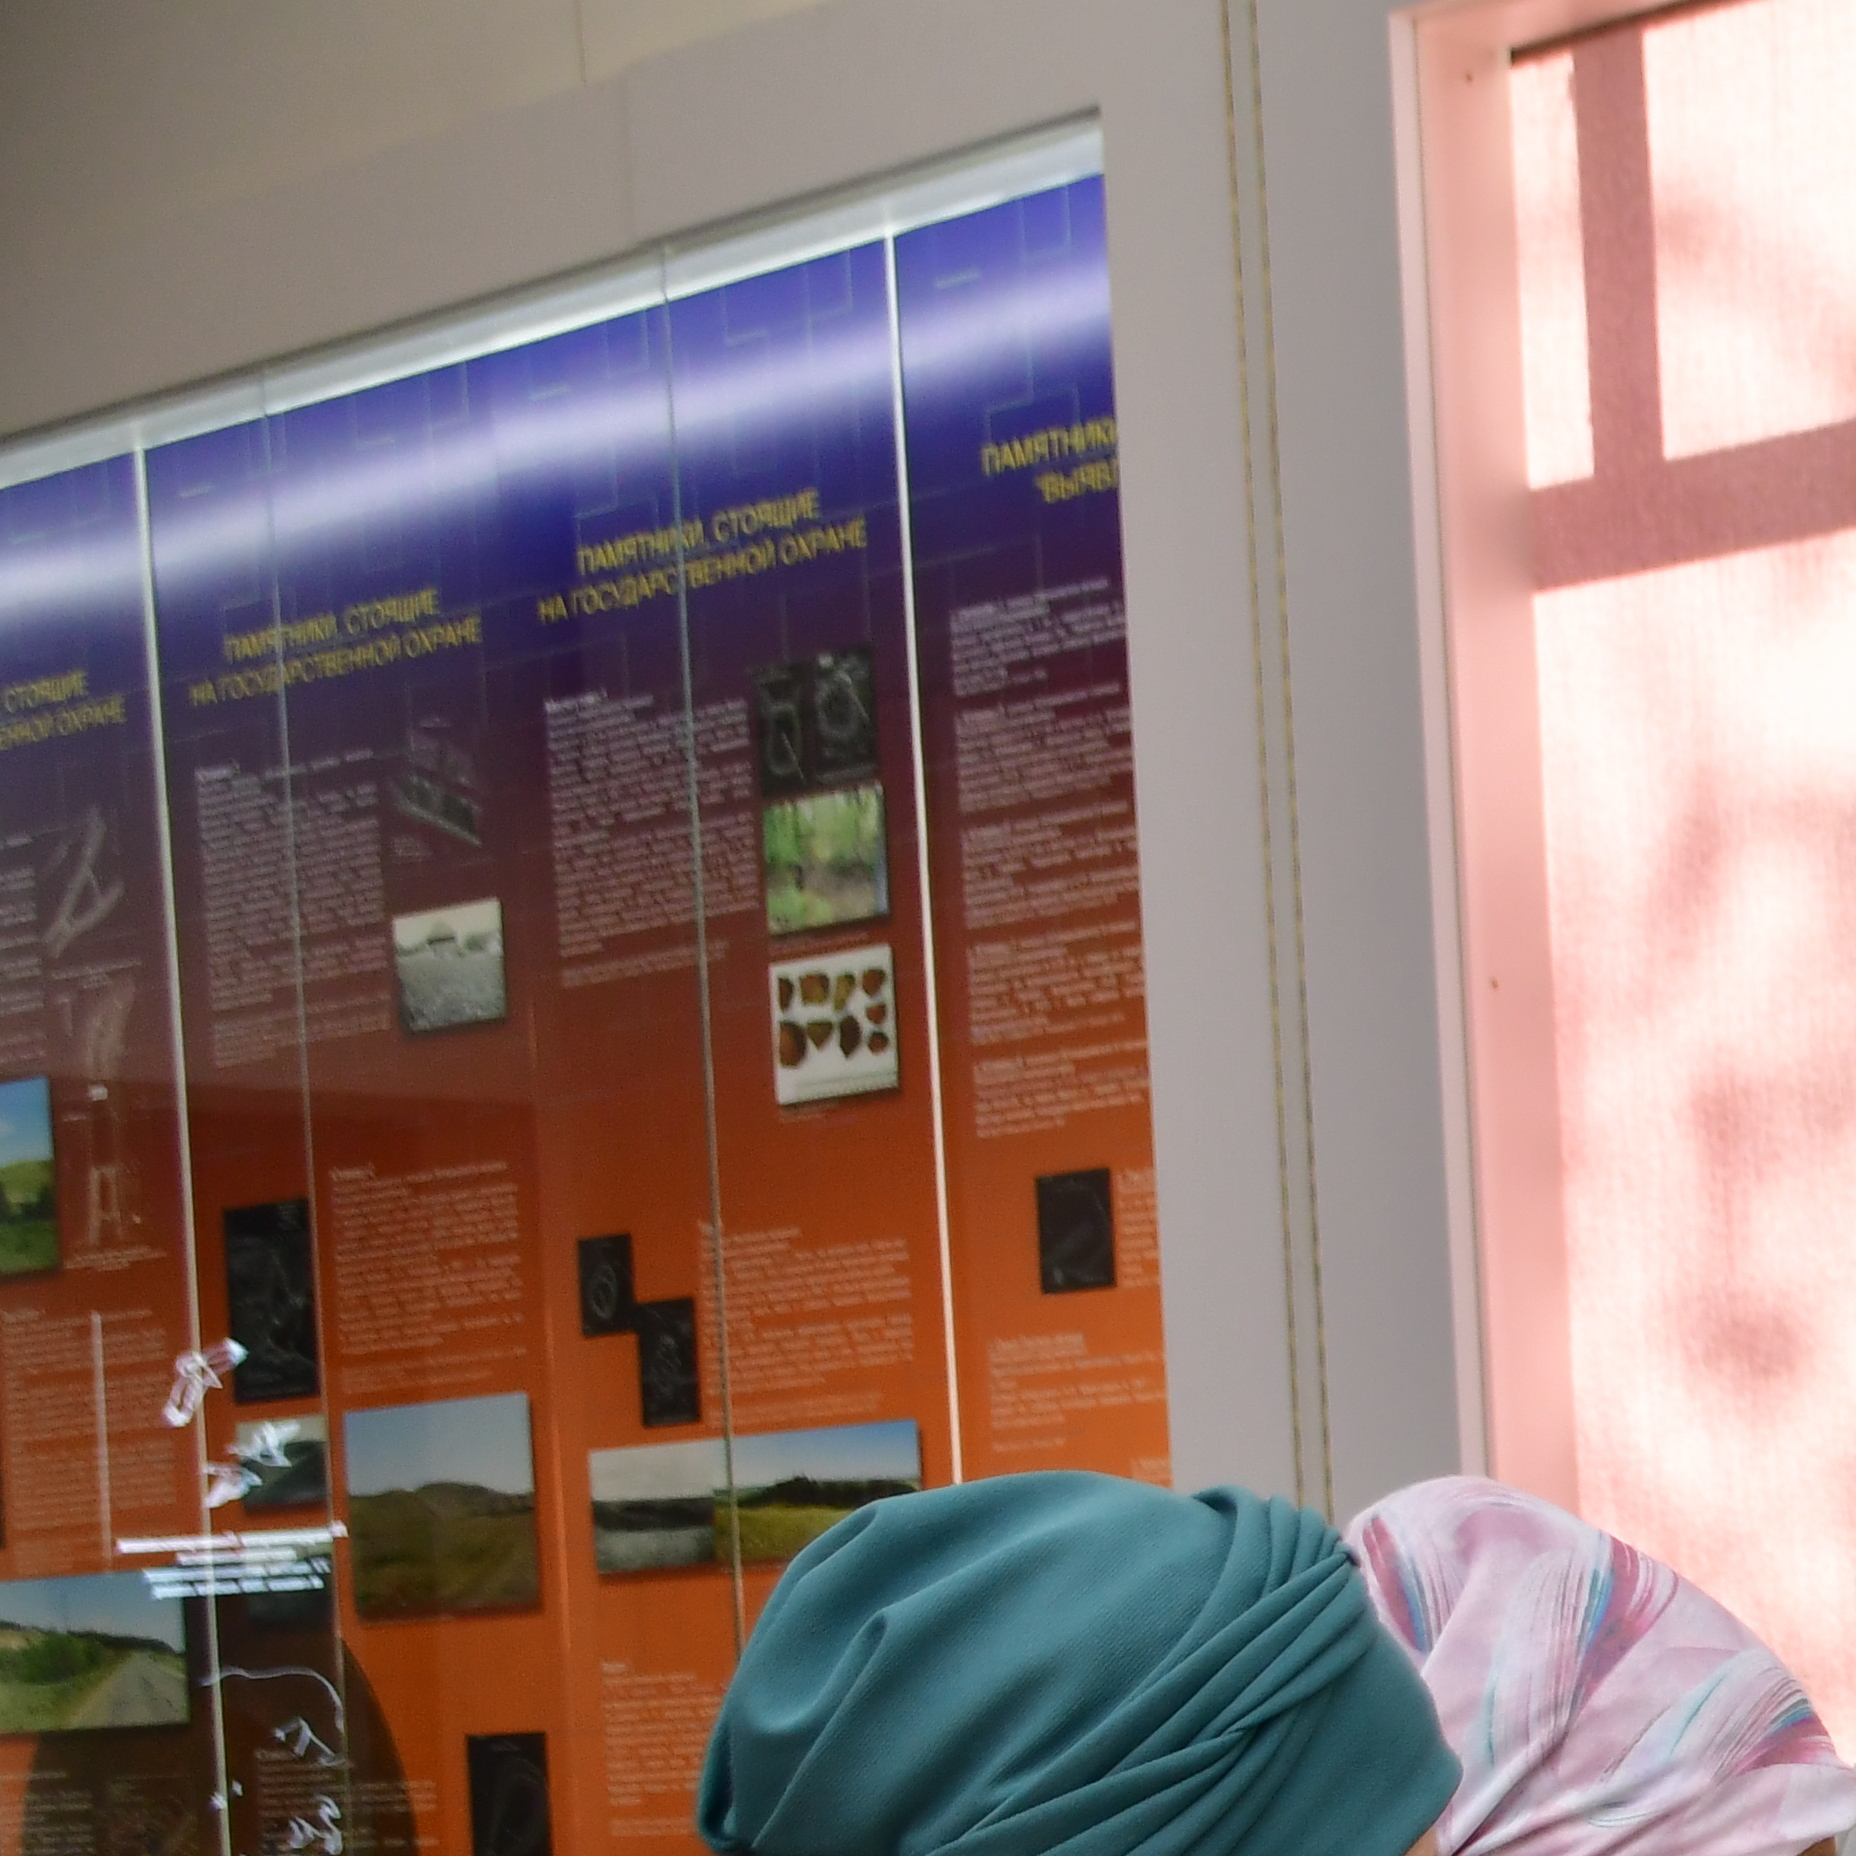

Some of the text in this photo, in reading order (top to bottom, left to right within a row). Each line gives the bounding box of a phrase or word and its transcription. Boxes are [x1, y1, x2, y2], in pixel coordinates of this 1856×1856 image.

[711, 487, 819, 544] СТОЯЩИЕ
[537, 593, 569, 626] НА
[778, 517, 867, 567] ОХРАНЕ
[344, 586, 440, 635] СТОЯЩИЕ
[188, 678, 219, 707] НА
[402, 614, 483, 659] ОХРАНЕ
